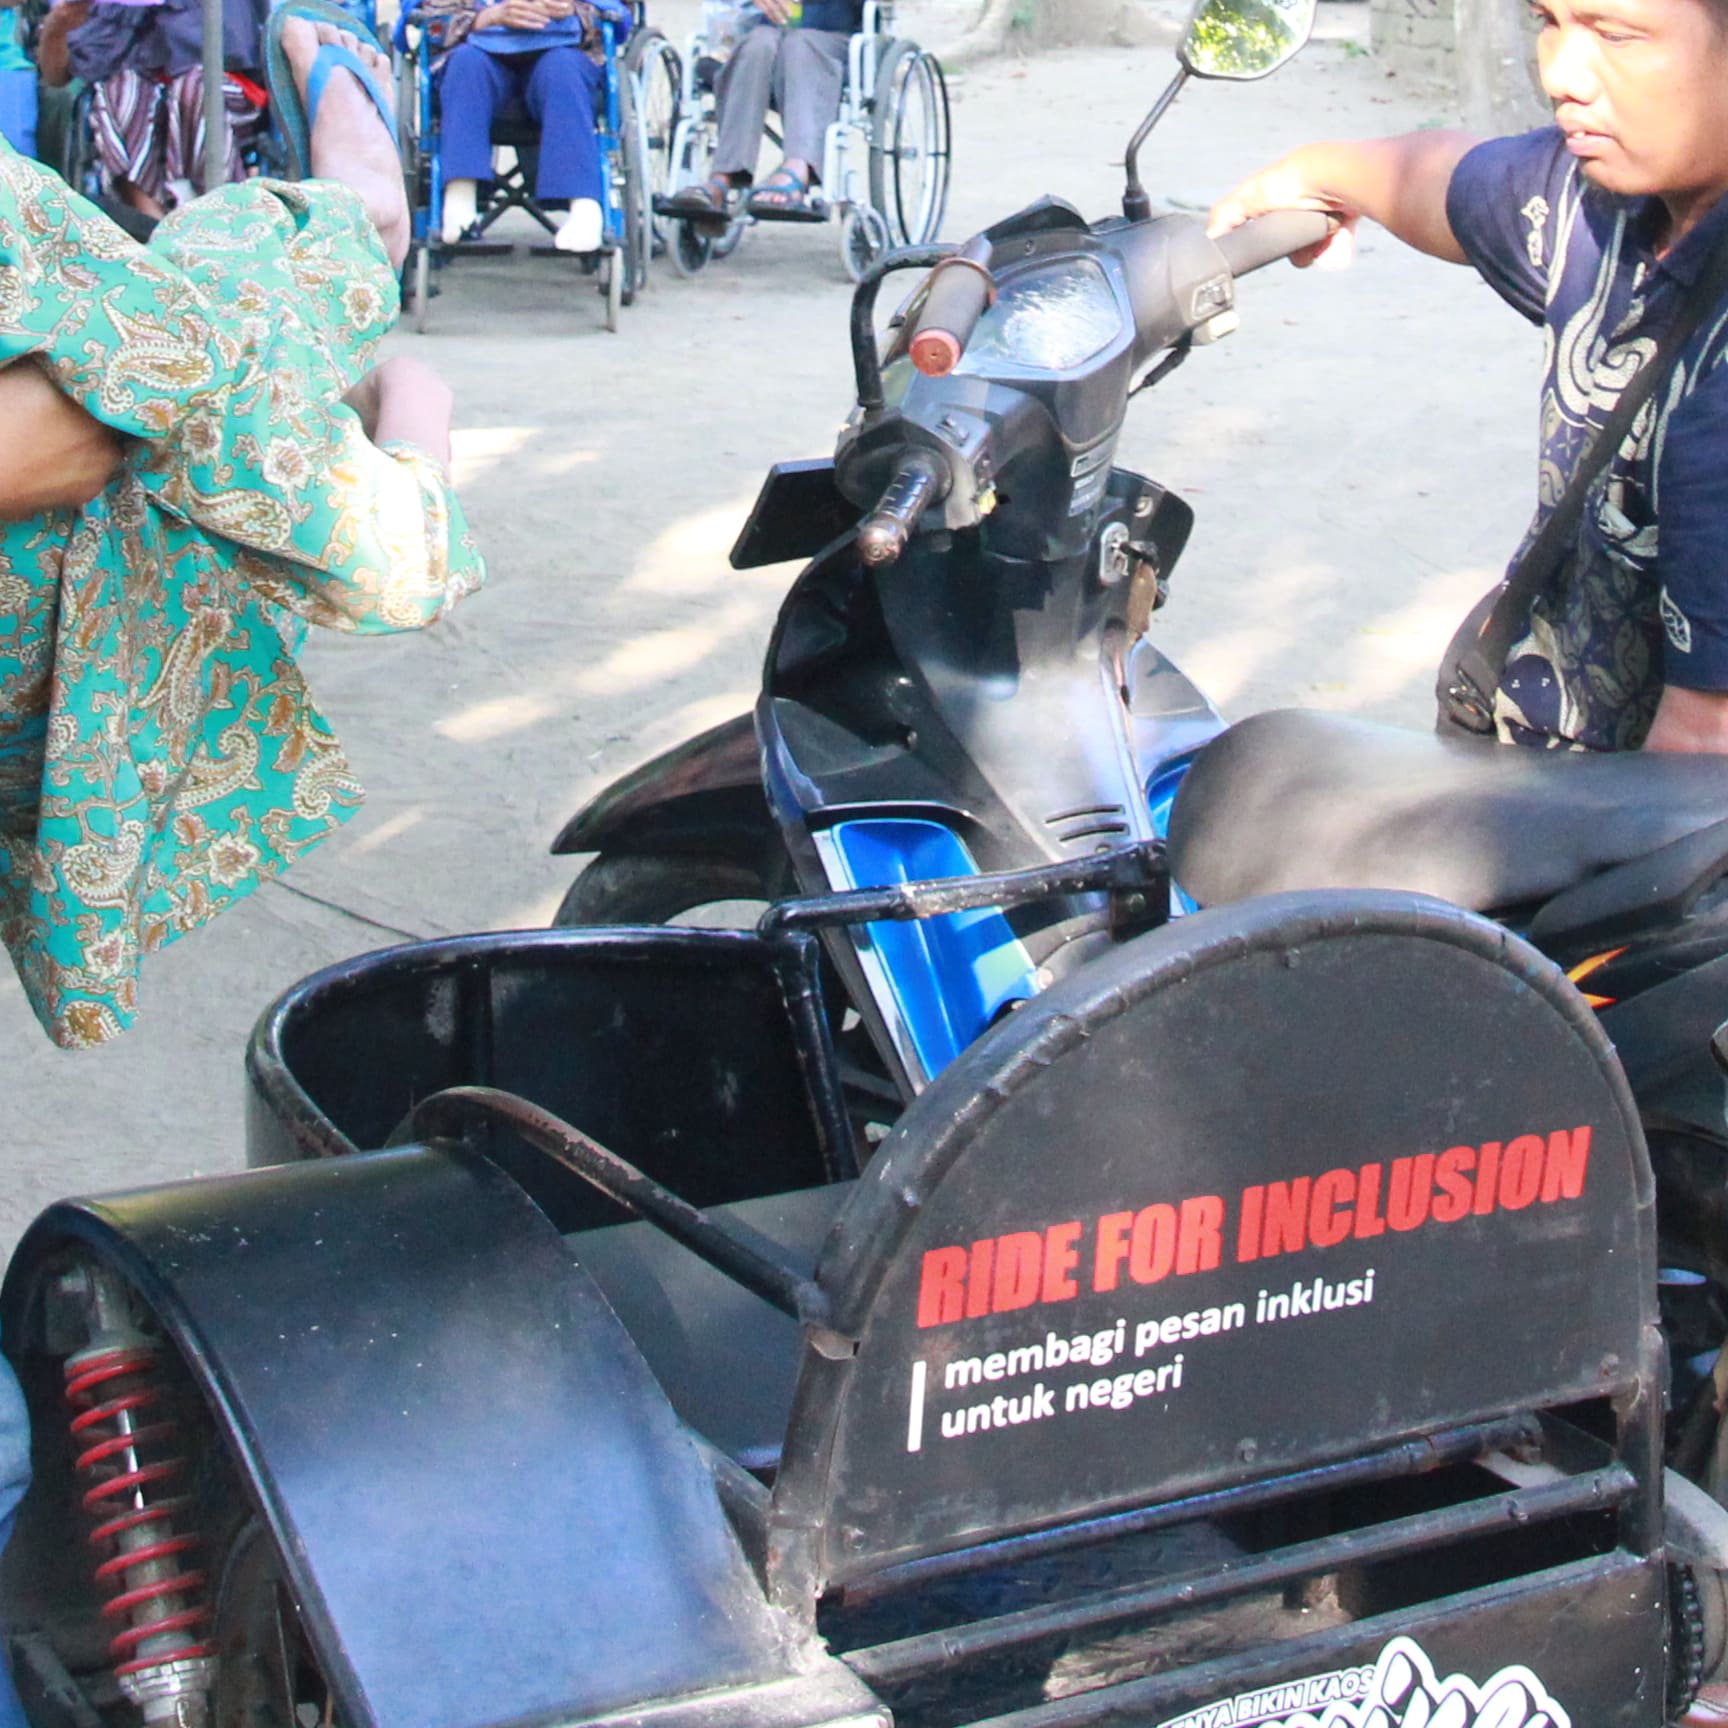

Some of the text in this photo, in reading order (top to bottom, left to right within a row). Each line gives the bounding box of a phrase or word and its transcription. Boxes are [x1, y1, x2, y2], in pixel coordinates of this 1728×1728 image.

[917, 1126, 1592, 1328] RIDE FOR INCLUSION
[944, 1269, 1376, 1389] membagi pesan inklusi
[941, 1354, 1185, 1437] untuk negeri
[1235, 1683, 1305, 1721] BIKIN
[1307, 1668, 1376, 1705] KAOS
